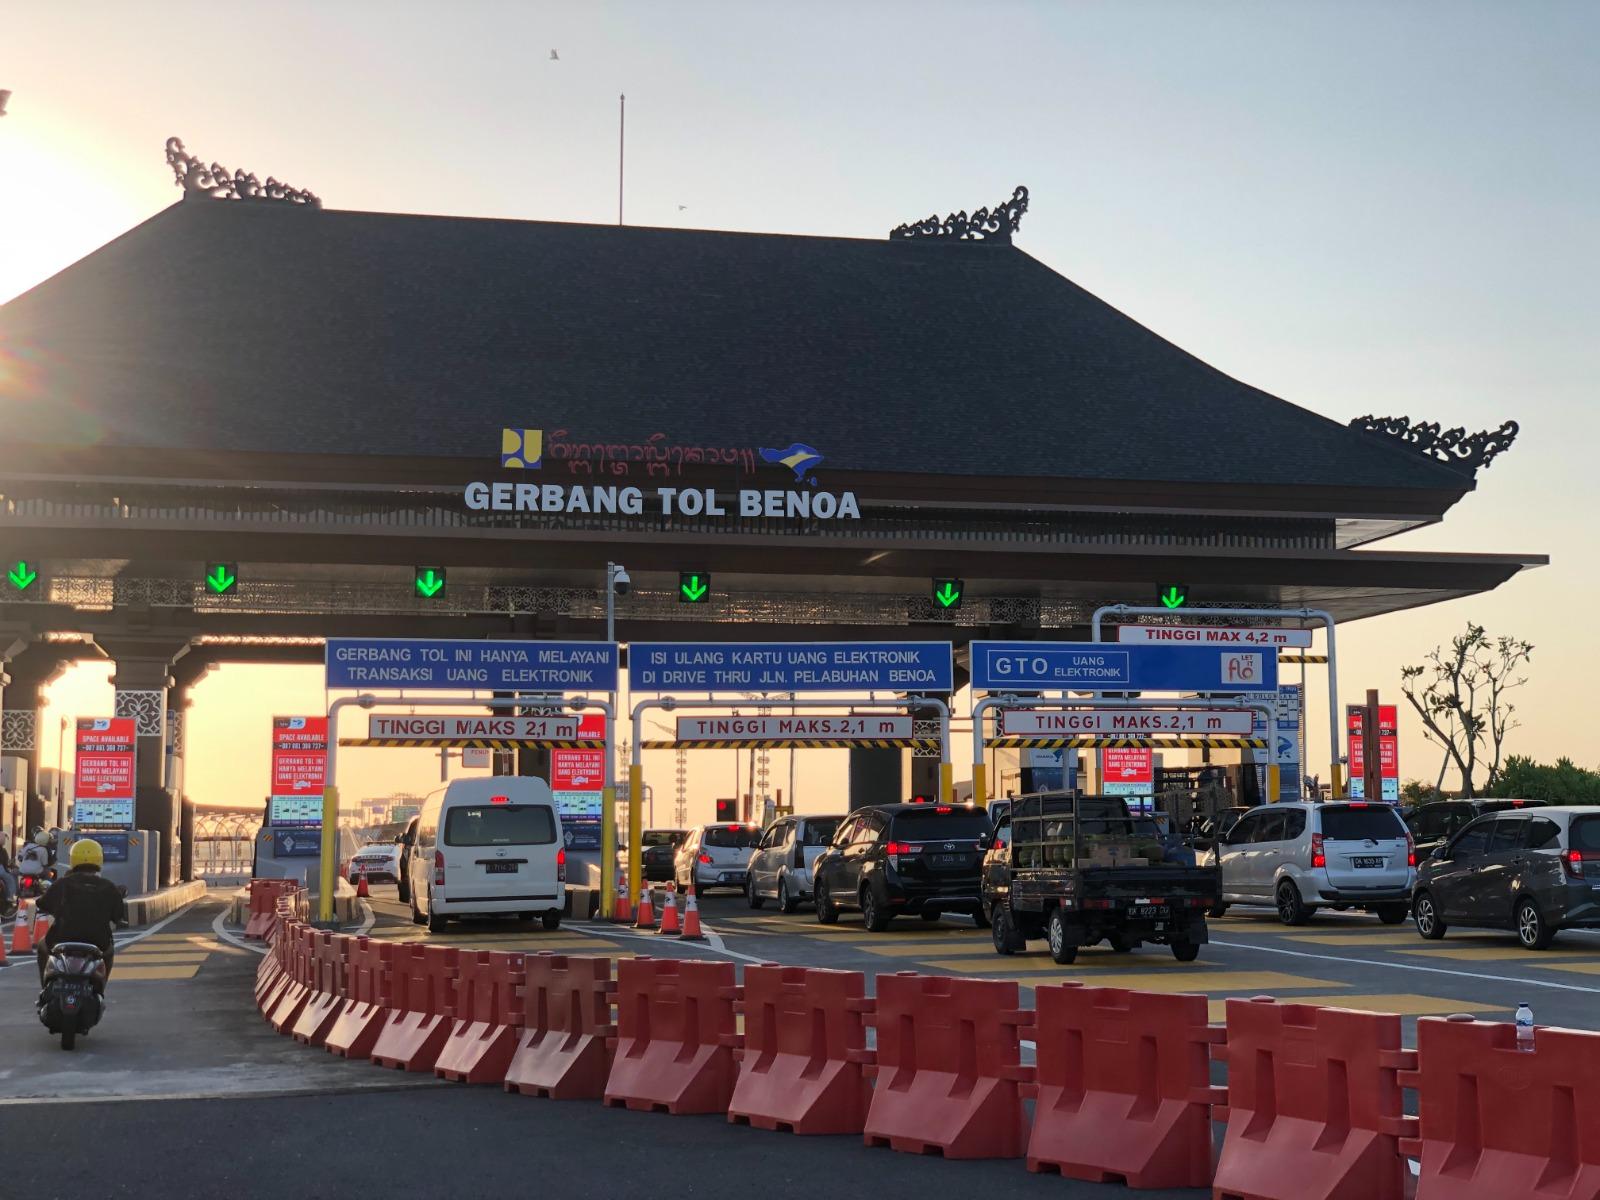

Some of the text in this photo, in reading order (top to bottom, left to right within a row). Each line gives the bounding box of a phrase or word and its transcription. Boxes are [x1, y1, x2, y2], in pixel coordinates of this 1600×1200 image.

[464, 482, 861, 519] GERBANG TOL BENOA
[1145, 629, 1288, 643] TINGGI MAX 4,2 m
[336, 648, 610, 664] GERBANG TOL INI HANYA MELAYANI
[651, 651, 921, 665] ISI ULANG KARTU UANG ELEKTRONIK
[1072, 656, 1105, 666] UANG
[995, 657, 1048, 675] GTO
[1054, 668, 1121, 677] ELEKTRONIK
[347, 667, 594, 682] TRANSAKSI UANG ELEKTRONIK
[642, 670, 936, 684] DI DRIVE THRU JLN. PELABUHAN BENOA
[377, 719, 573, 737] TINGGI MAKS 2,1 m
[697, 720, 766, 734] TINGGI
[879, 721, 895, 733] m
[1036, 715, 1101, 729] TINGGI
[1207, 716, 1222, 729] m
